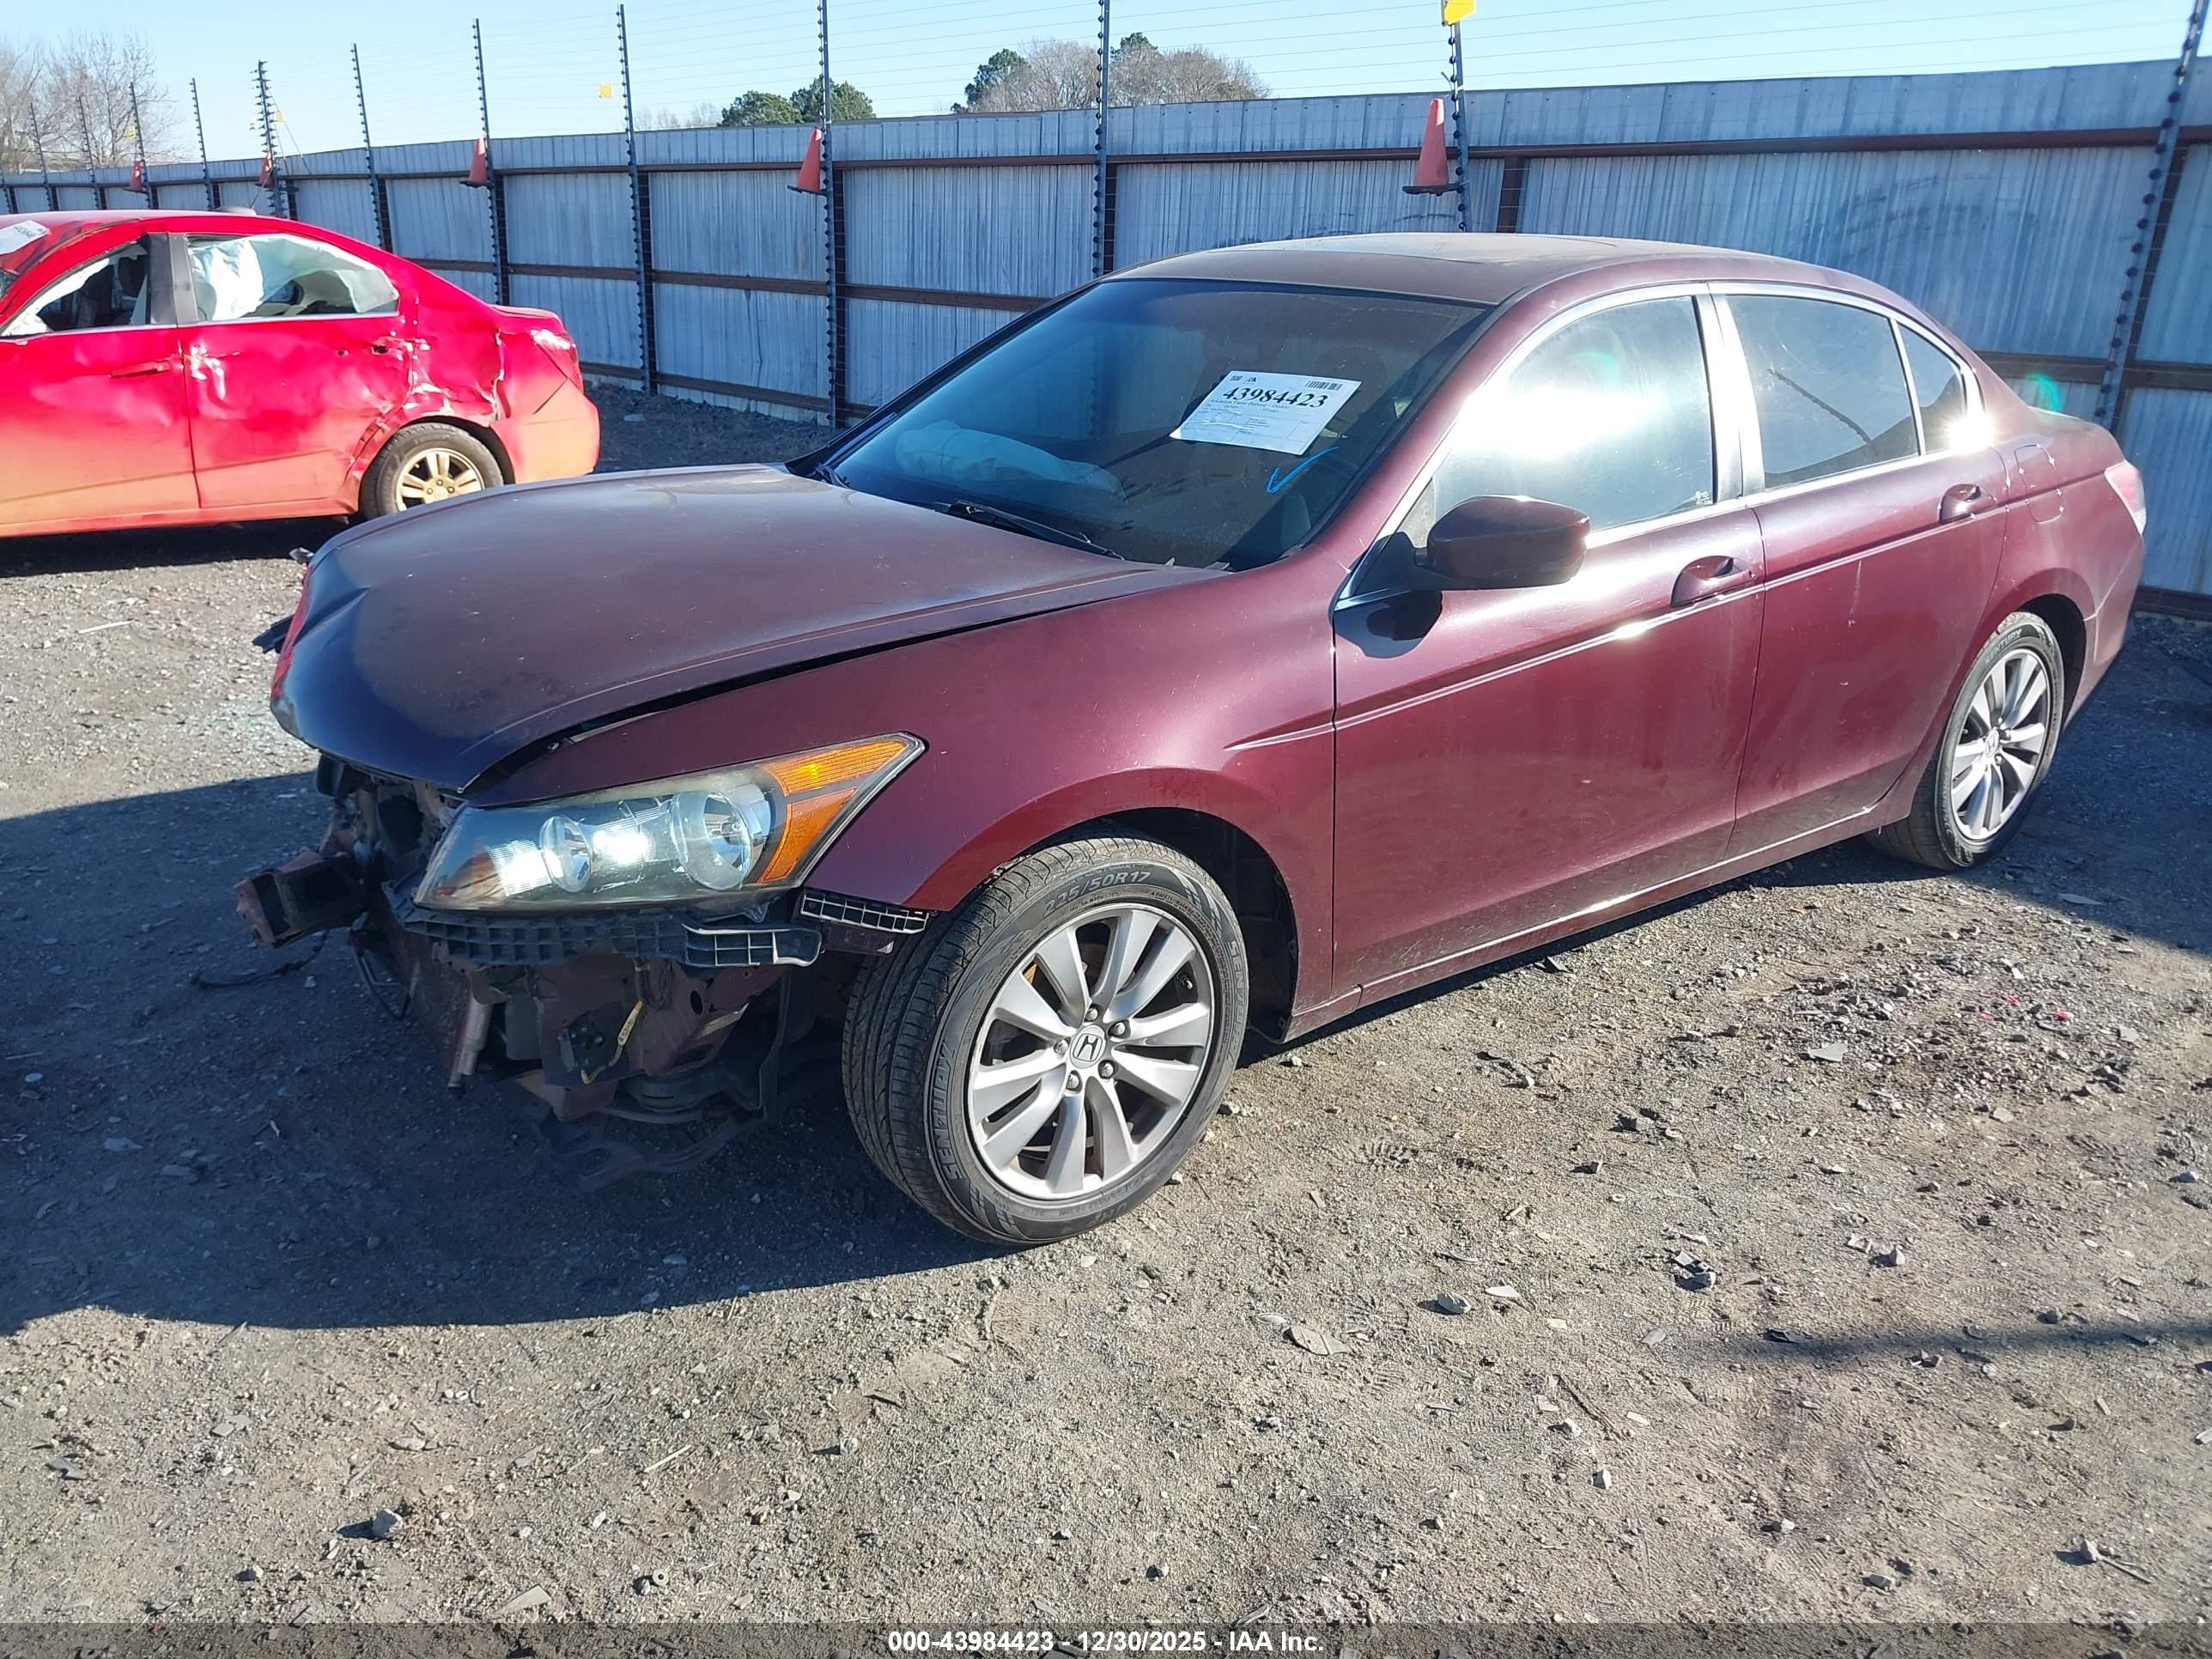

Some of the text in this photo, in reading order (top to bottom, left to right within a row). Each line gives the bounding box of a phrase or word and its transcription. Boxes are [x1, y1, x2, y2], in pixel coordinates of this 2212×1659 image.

[1223, 386, 1328, 408] 43984423
[1042, 870, 1152, 918] 225/50R17
[930, 1040, 963, 1181] SENTURY
